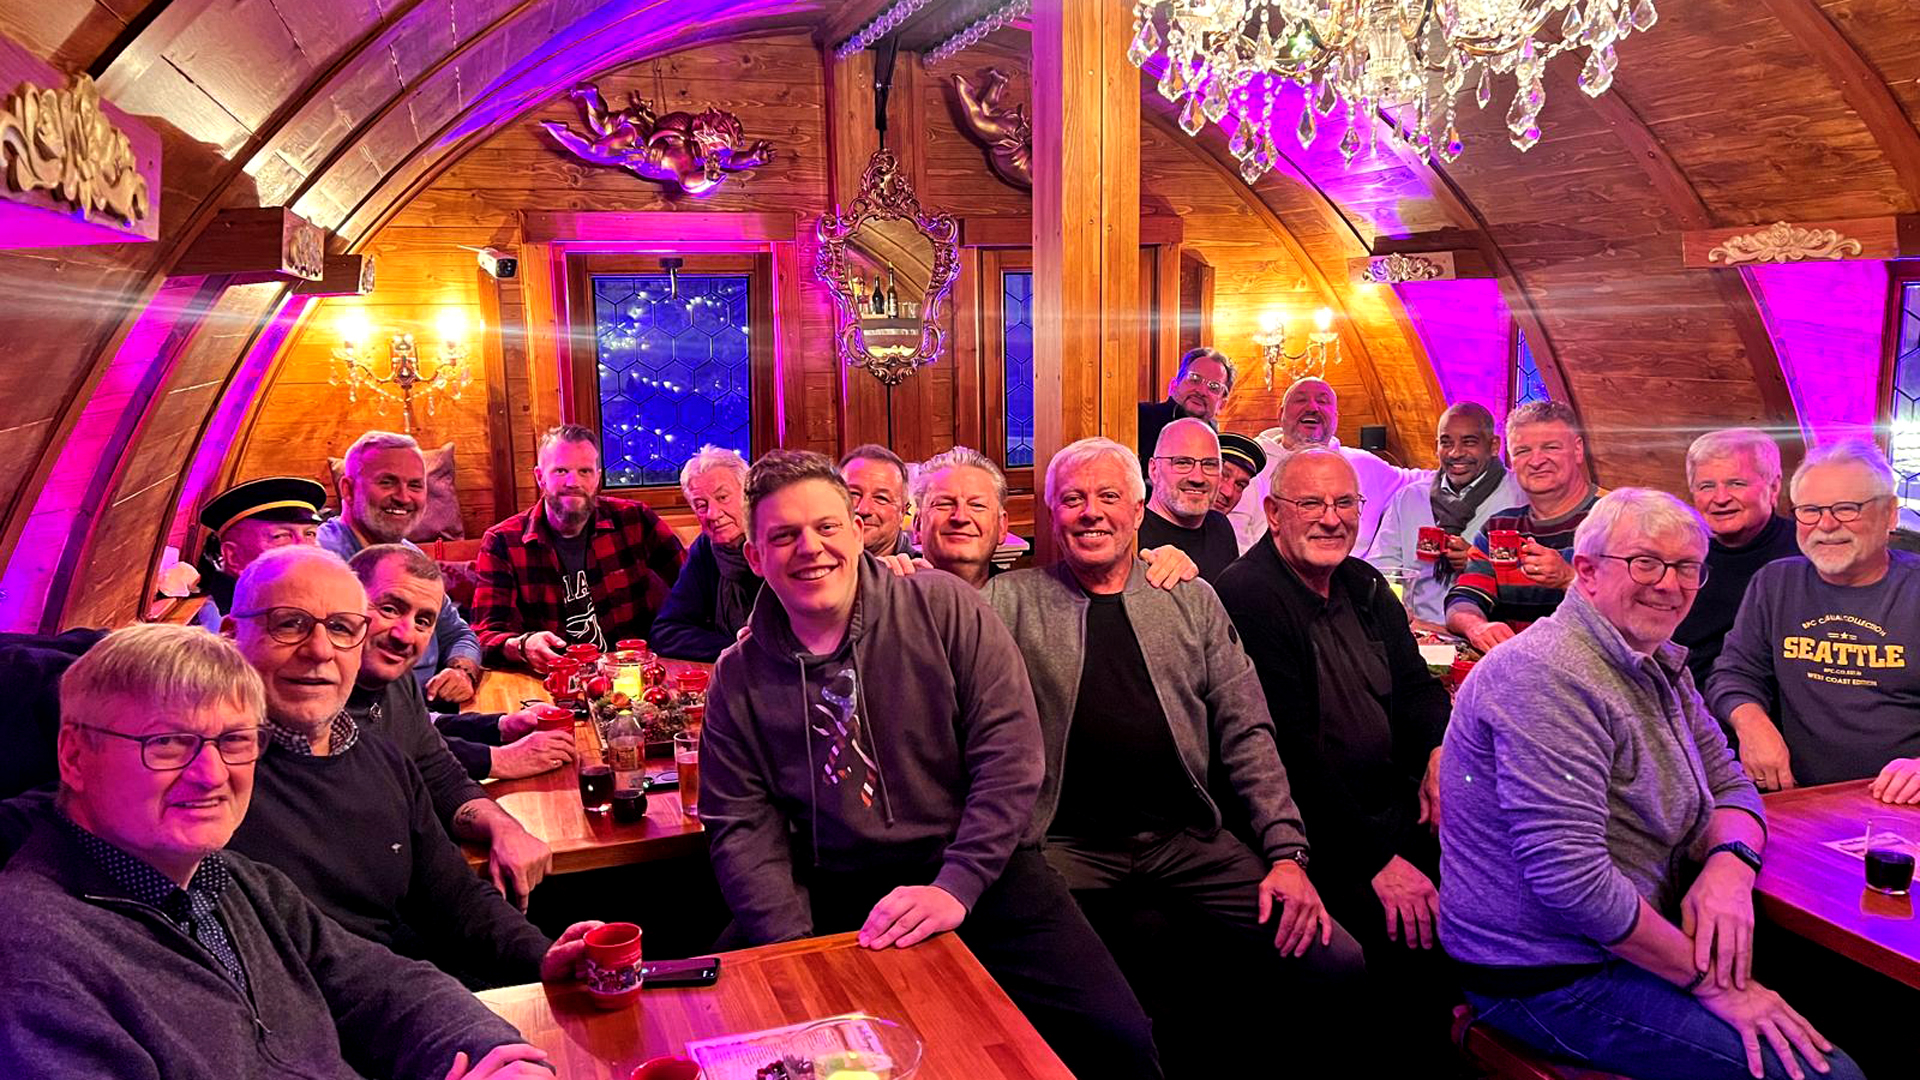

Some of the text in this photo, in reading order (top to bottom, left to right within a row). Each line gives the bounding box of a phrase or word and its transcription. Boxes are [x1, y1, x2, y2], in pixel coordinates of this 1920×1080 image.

[1783, 636, 1905, 668] SEATTLE
[1806, 672, 1825, 681] WEST
[1825, 676, 1850, 685] COAST
